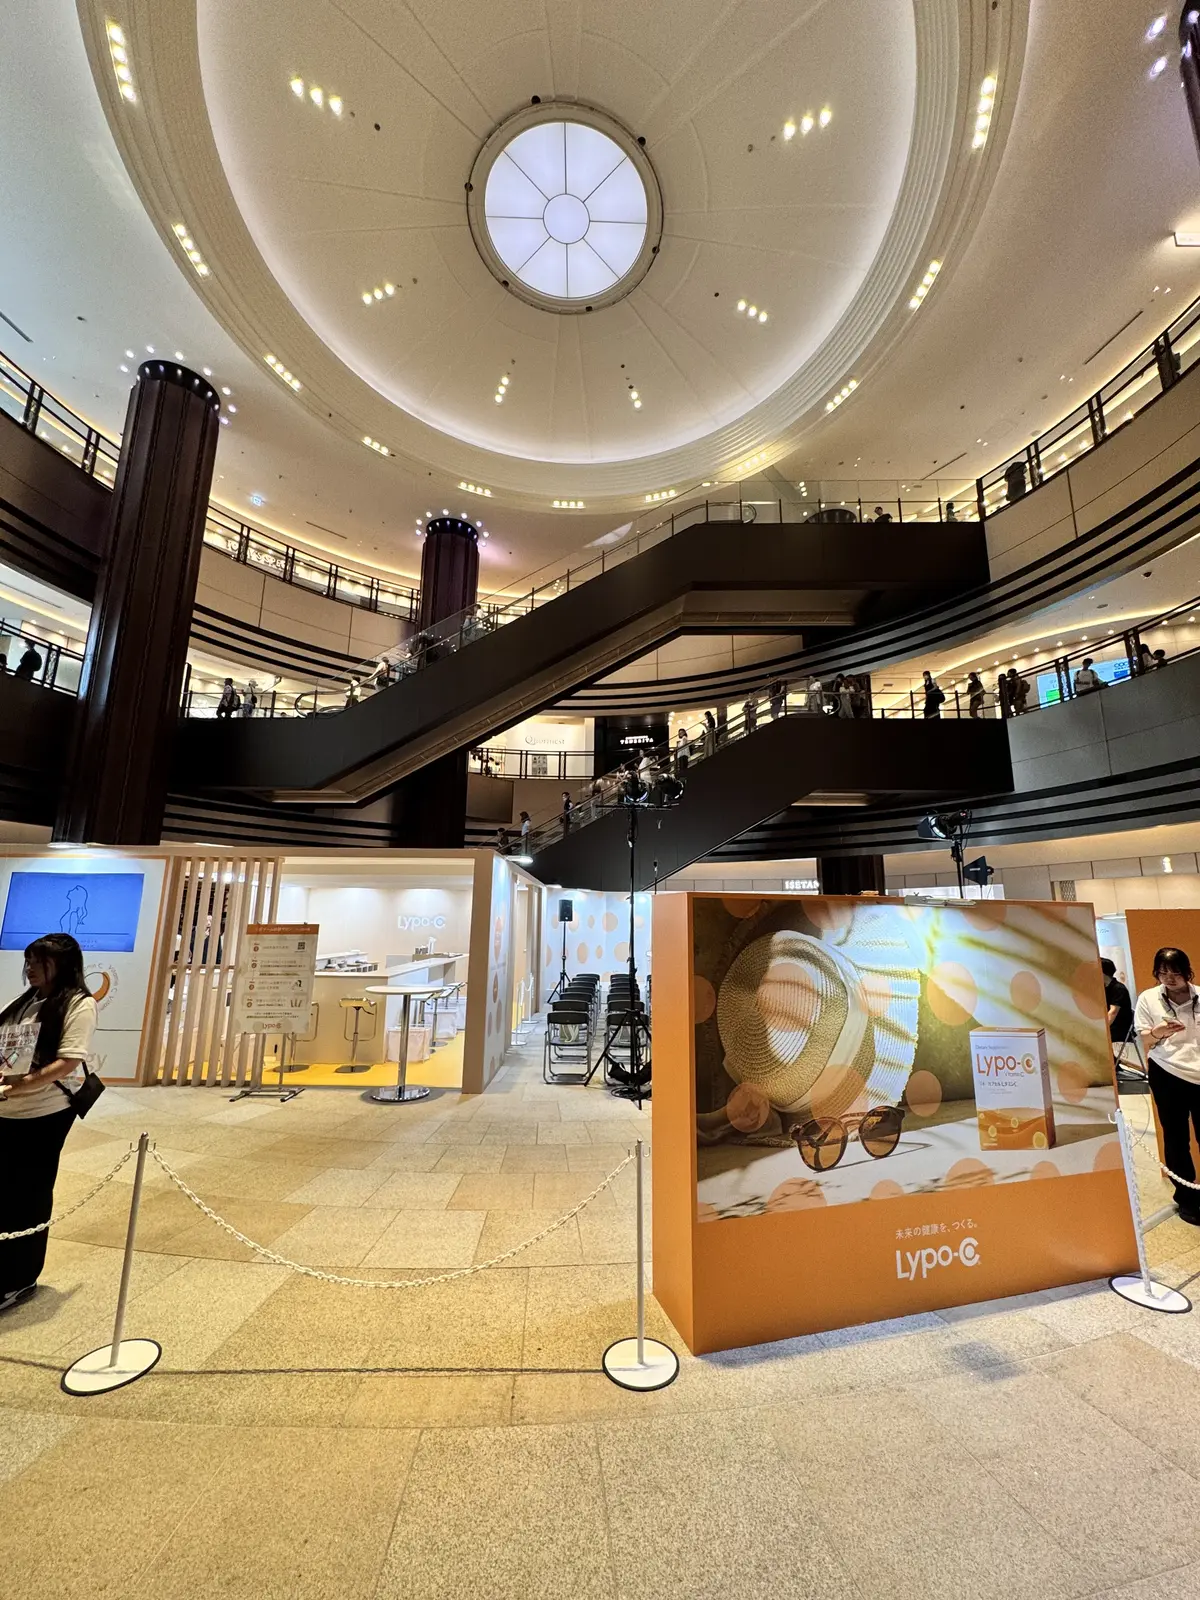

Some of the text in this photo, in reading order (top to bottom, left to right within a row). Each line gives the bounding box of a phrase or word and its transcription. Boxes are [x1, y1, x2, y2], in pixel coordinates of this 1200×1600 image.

[398, 915, 427, 931] Lypo-C
[976, 1053, 1037, 1077] Lypo-C
[896, 1219, 978, 1240] 未来の健康を、つくる。
[896, 1237, 981, 1281] Lypo-C
